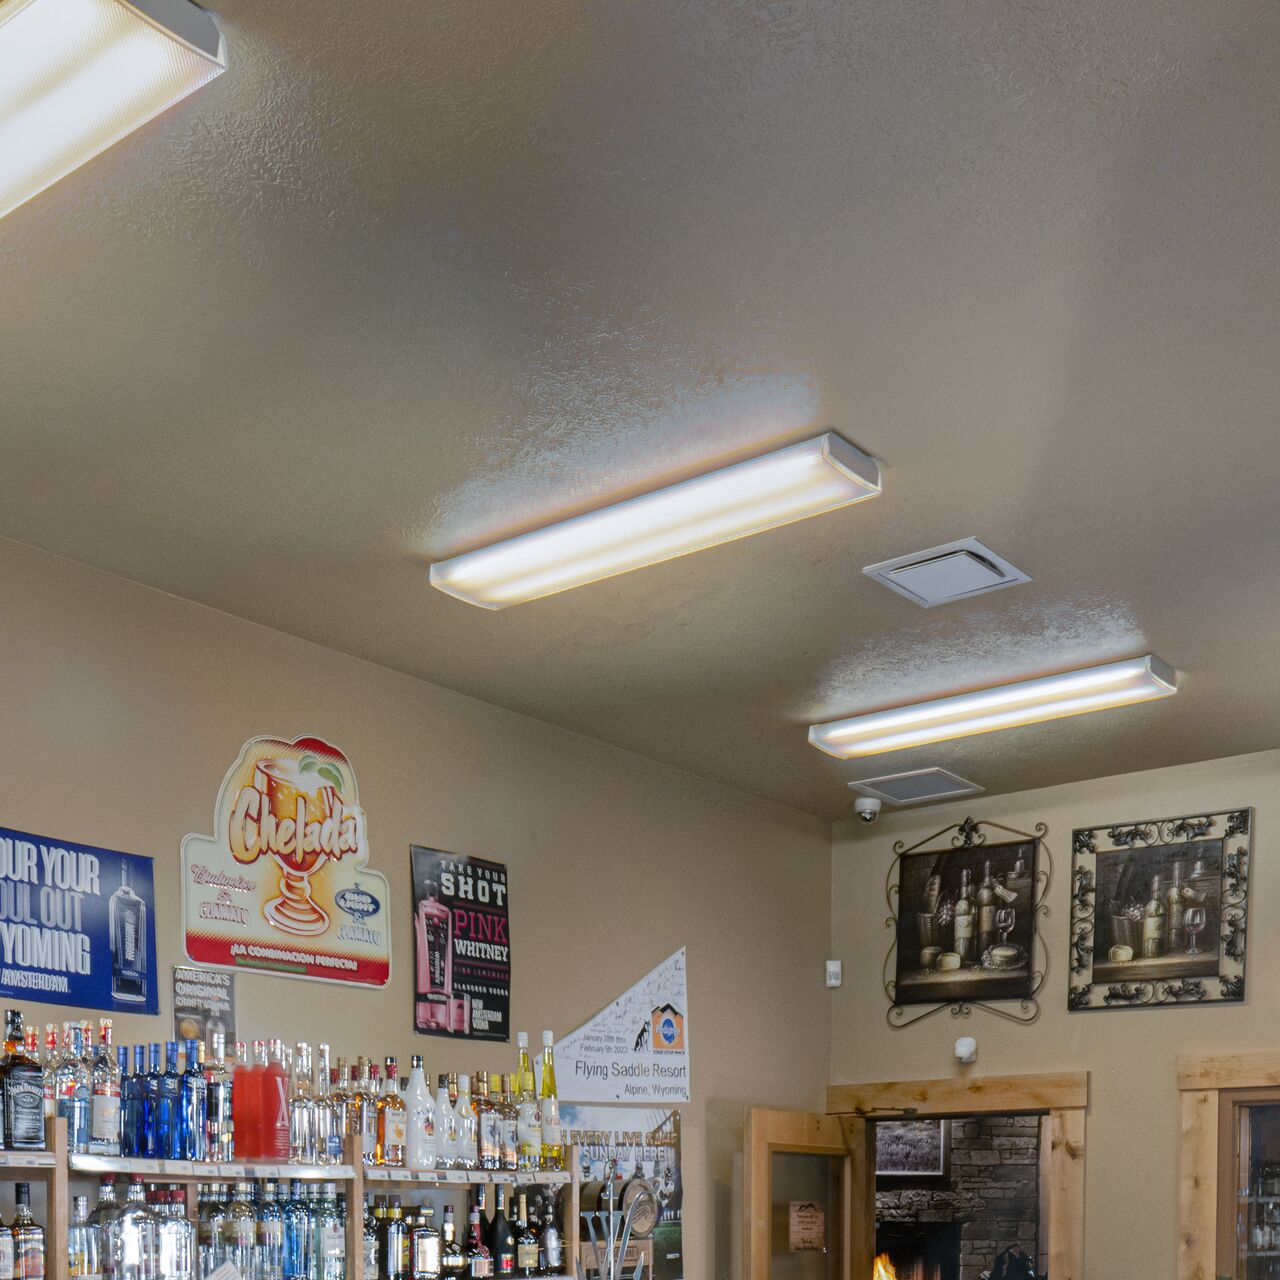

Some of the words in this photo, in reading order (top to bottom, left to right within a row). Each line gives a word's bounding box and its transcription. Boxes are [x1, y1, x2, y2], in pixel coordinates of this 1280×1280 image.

[229, 786, 358, 865] Chelada
[40, 844, 100, 896] YOUR
[440, 860, 473, 876] TAKE
[477, 866, 506, 884] YOUR
[440, 872, 506, 906] SHOT
[40, 886, 85, 932] OUT
[454, 909, 508, 945] PINK
[454, 938, 508, 962] WHITNEY
[0, 968, 68, 993] AMSTERDAM
[575, 1060, 608, 1080] Flying
[611, 1061, 650, 1078] Saddle
[653, 1062, 687, 1078] Resort
[624, 1083, 650, 1098] Alpine,
[653, 1084, 687, 1098] Wyoming
[571, 1130, 612, 1146] EVERY
[614, 1131, 643, 1146] LIVE
[582, 1146, 631, 1162] SUNDAY
